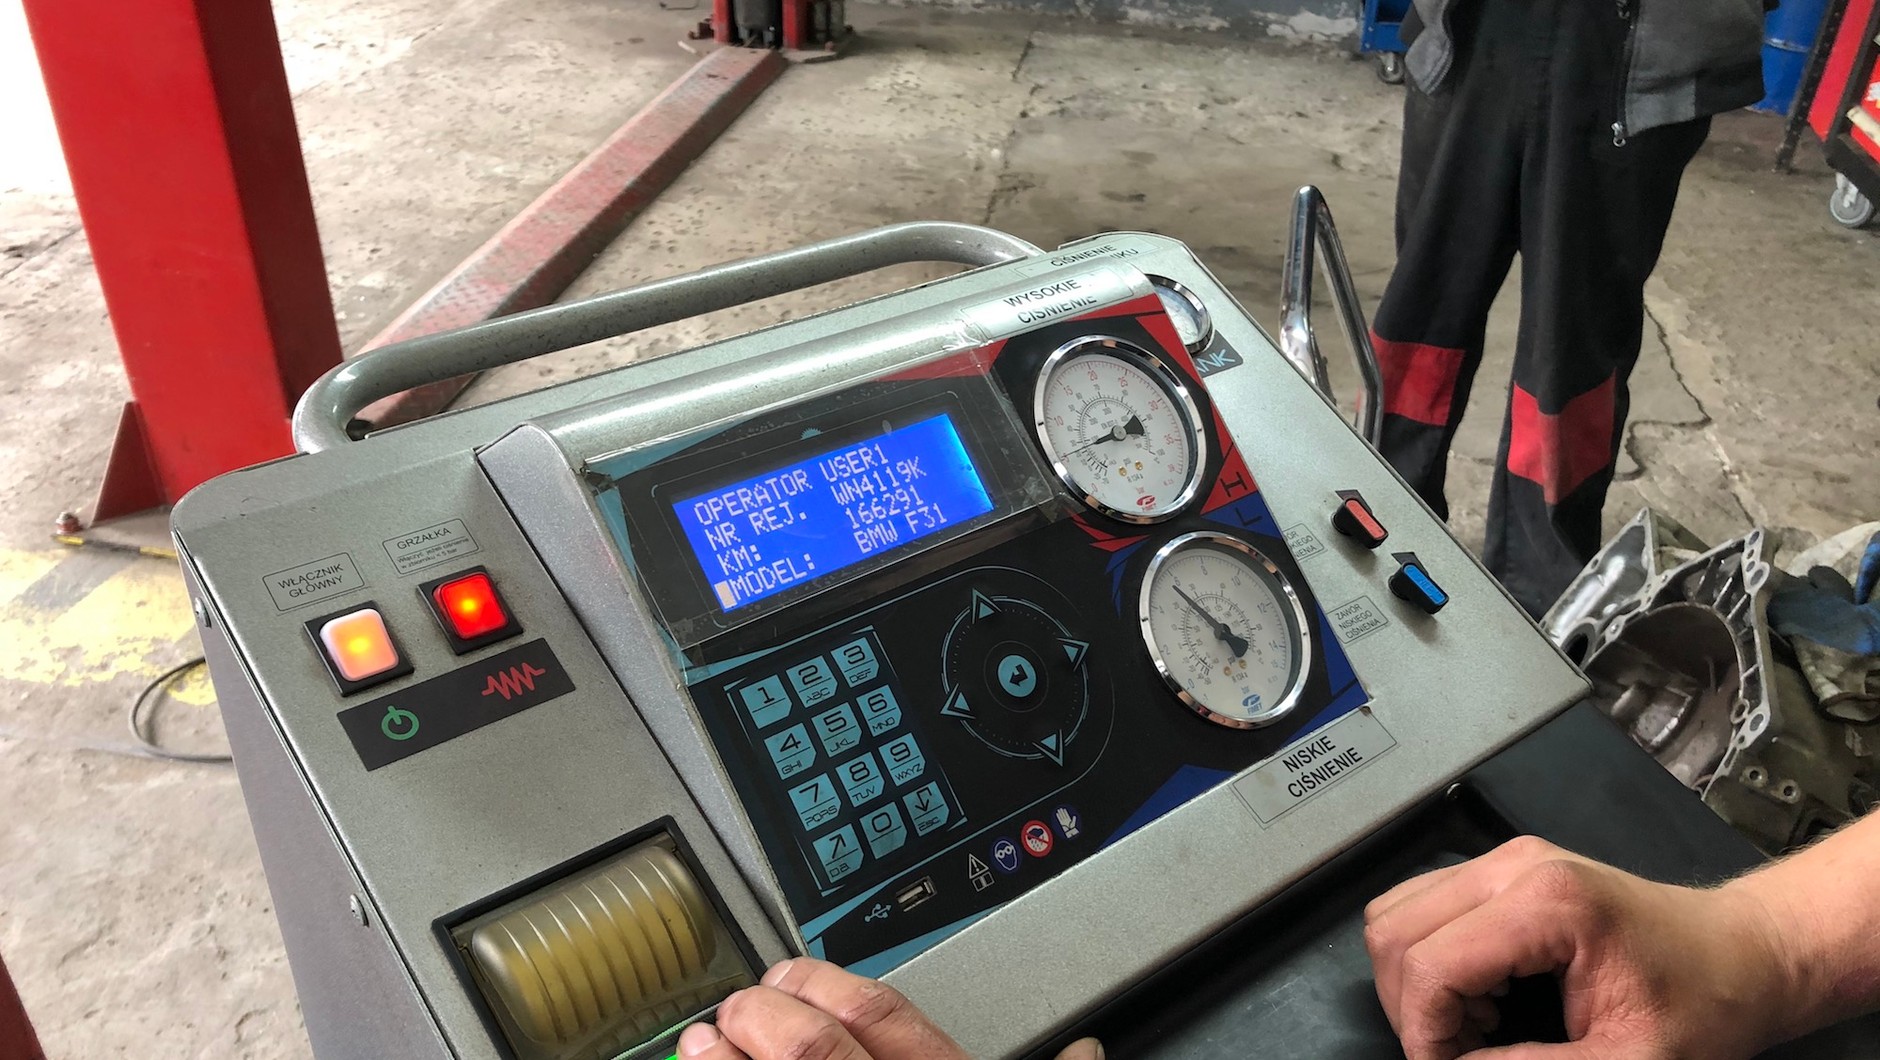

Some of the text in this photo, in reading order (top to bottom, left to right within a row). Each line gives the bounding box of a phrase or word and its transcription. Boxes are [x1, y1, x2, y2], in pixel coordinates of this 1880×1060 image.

[1003, 279, 1082, 308] WYSOKIE
[1196, 349, 1236, 373] NK
[1087, 370, 1098, 382] 20
[1053, 415, 1064, 426] 10
[694, 443, 889, 526] OPERATOR USER1
[1220, 471, 1248, 498] H
[705, 456, 928, 551] NR REJ. WN4119K
[1235, 508, 1262, 526] L
[396, 527, 452, 550] GRZAŁKA
[717, 484, 925, 576] KM: 166291
[729, 503, 948, 601] MODEL: BMW F31
[1291, 535, 1314, 549] KIEGO
[1296, 545, 1317, 558] IENIA
[1257, 602, 1268, 614] 12
[1338, 610, 1373, 630] NISKIEGO
[843, 644, 866, 665] 3
[798, 664, 823, 685] 2
[849, 668, 873, 684] DEF
[757, 687, 775, 704] 1
[806, 687, 831, 704] ABC
[867, 693, 888, 713] 6
[823, 710, 847, 733] 5
[872, 716, 896, 733] MNO
[779, 732, 802, 753] 4
[829, 737, 856, 753] JKL
[890, 741, 911, 763] 9
[1281, 735, 1337, 774] NISKIE
[781, 760, 803, 775] GHI
[849, 760, 871, 782] 8
[894, 763, 923, 781] WXYZ
[1286, 747, 1363, 799] CIŚNIENIE
[799, 782, 819, 803] 7
[852, 785, 875, 801] TUV
[804, 805, 838, 827] PQRS
